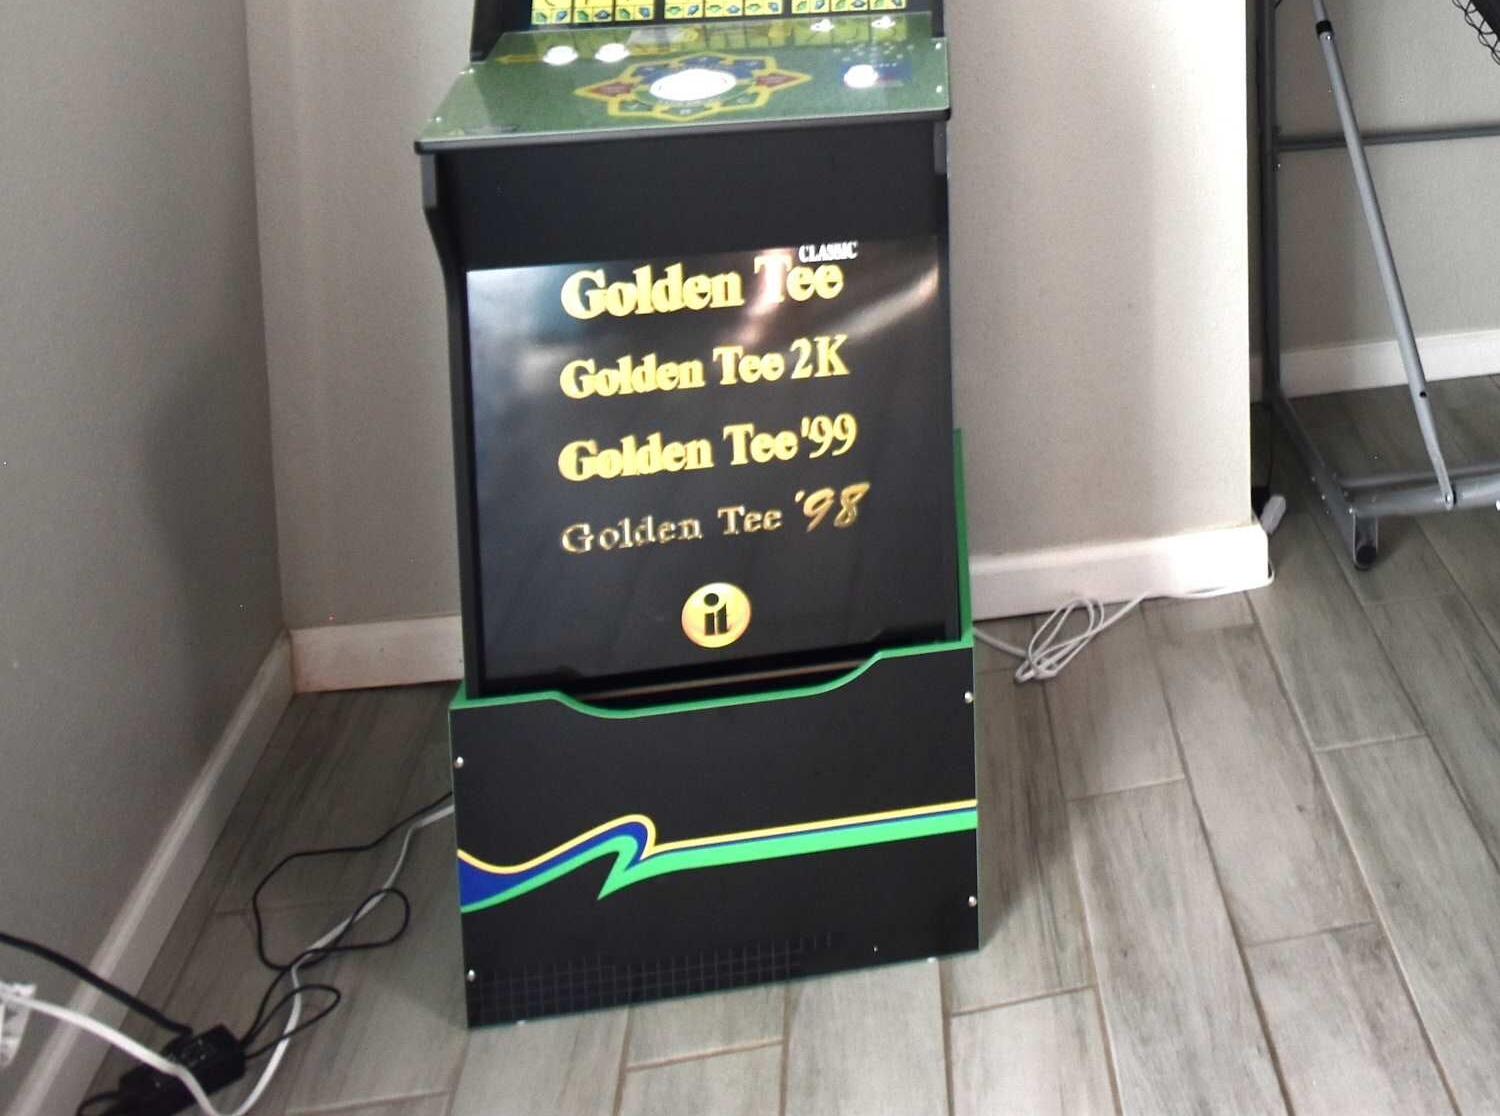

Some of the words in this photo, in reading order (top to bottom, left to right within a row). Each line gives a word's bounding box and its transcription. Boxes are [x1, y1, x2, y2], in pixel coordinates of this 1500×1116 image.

[798, 240, 859, 263] CLASSIC
[560, 261, 745, 320] Golden
[753, 253, 845, 304] Tee
[559, 352, 707, 400] Golden
[712, 344, 786, 386] Tee
[790, 333, 851, 381] 2K
[558, 431, 716, 482] Golden
[721, 422, 799, 467] Tee
[560, 514, 705, 555] Golden
[717, 504, 783, 536] Tee
